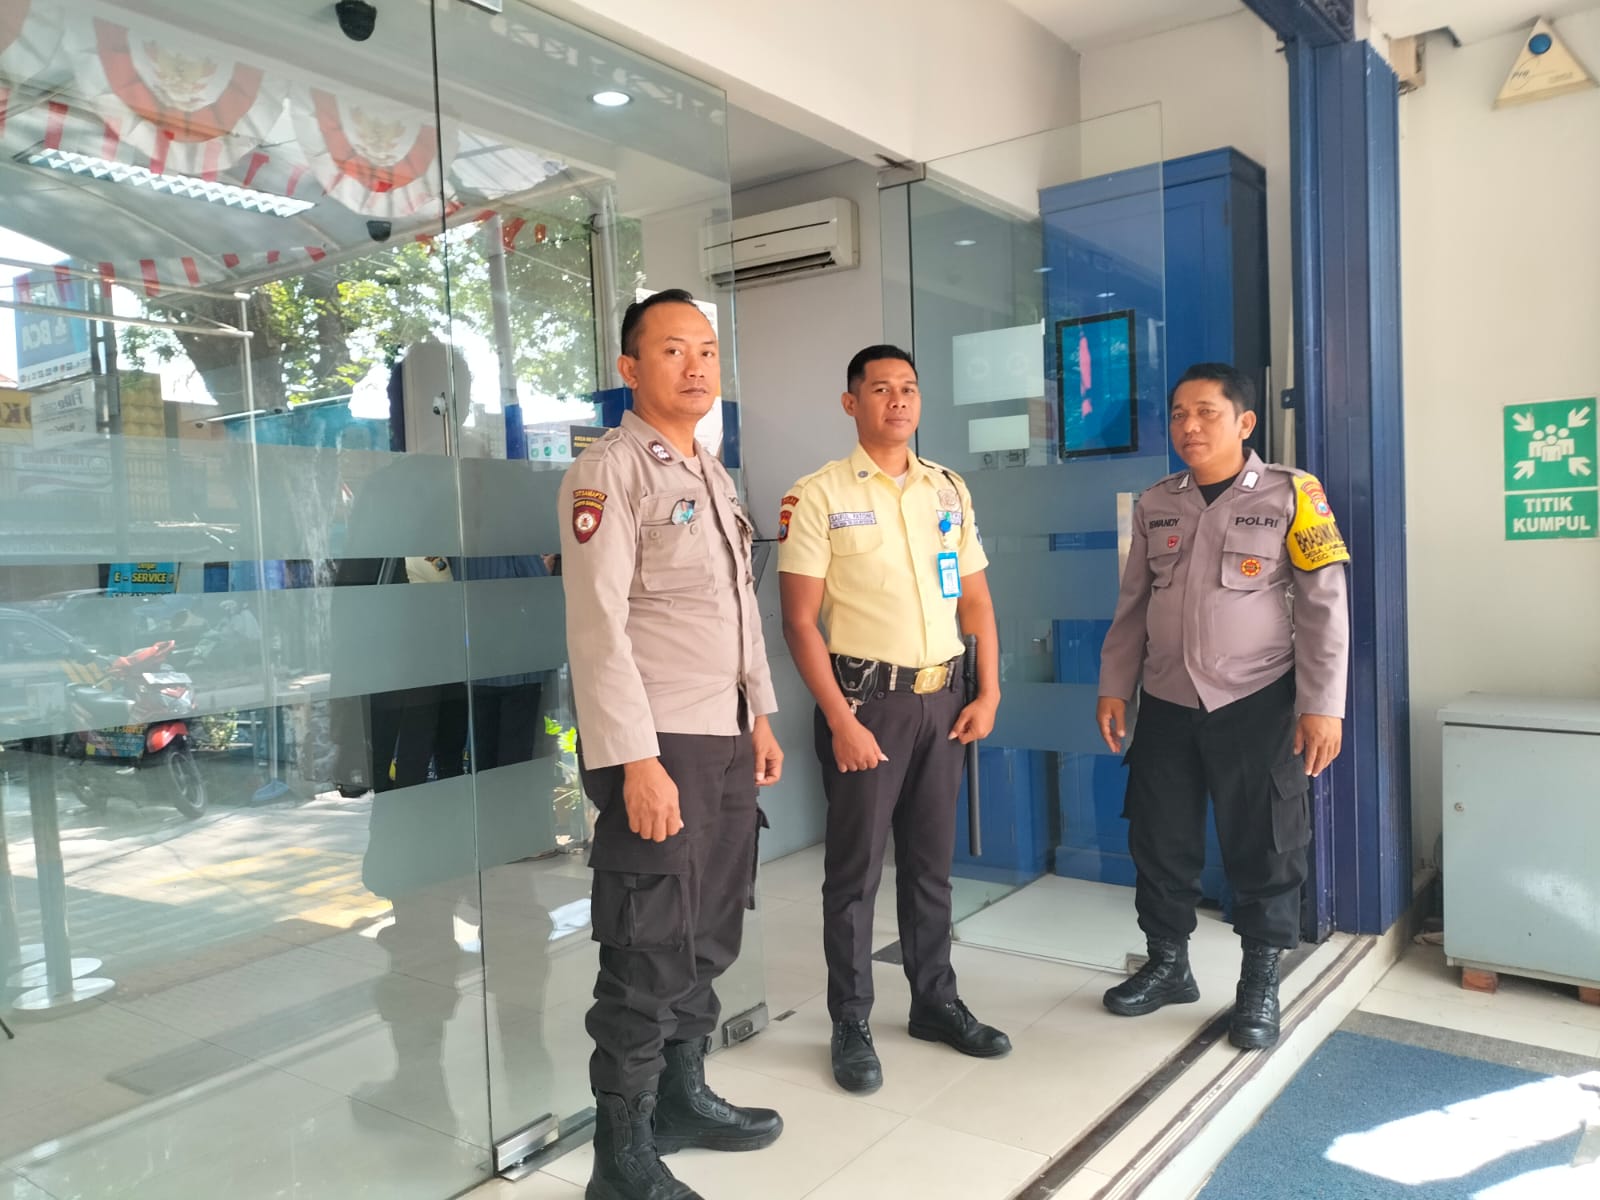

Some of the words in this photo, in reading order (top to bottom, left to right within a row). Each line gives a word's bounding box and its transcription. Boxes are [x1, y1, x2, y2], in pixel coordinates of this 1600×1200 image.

[1523, 496, 1574, 513] TITIK
[1235, 516, 1279, 528] POLRI
[1513, 515, 1591, 533] KUMPUL
[131, 571, 167, 584] SERVICE
